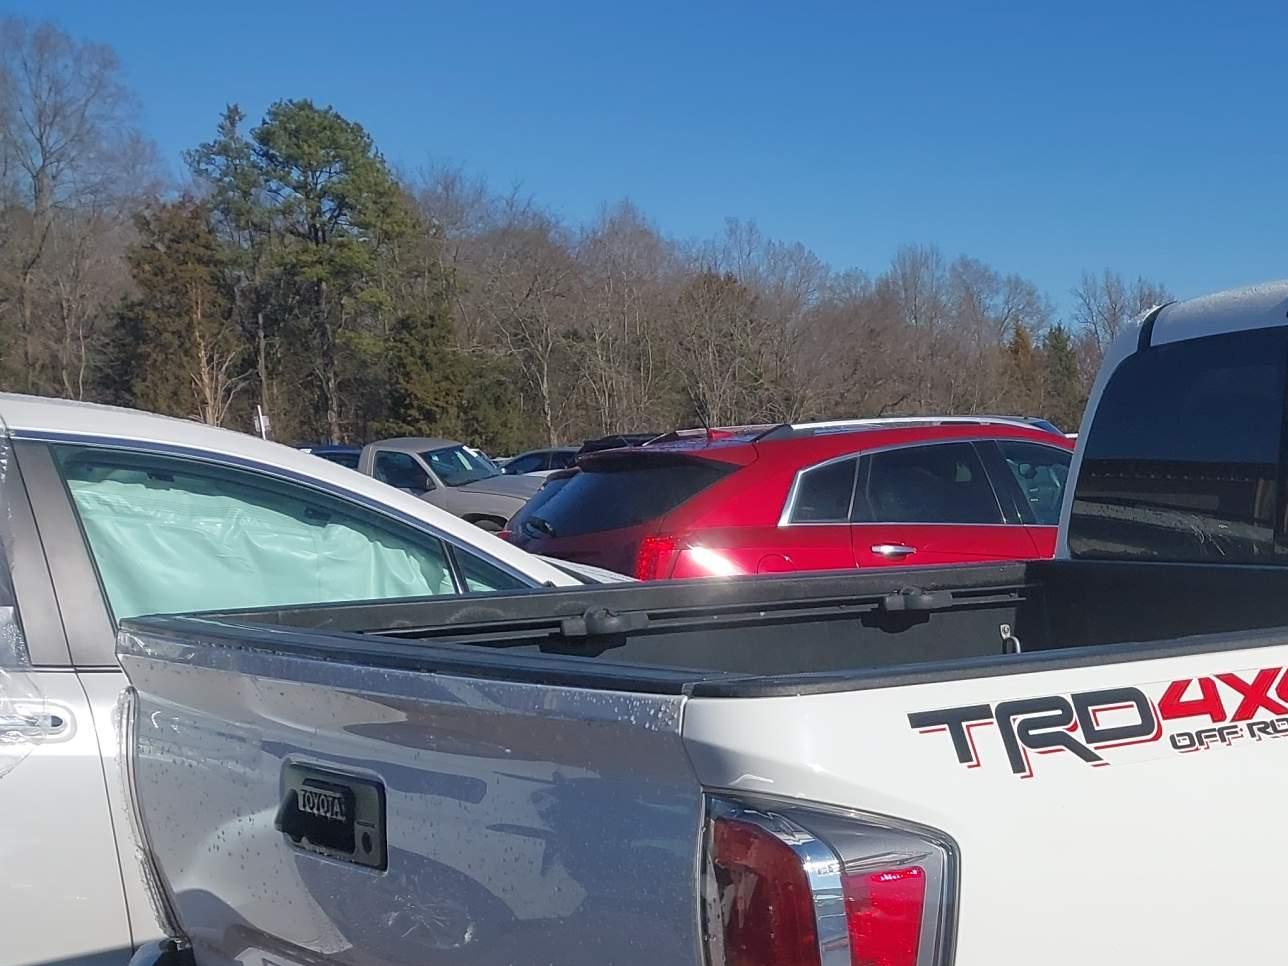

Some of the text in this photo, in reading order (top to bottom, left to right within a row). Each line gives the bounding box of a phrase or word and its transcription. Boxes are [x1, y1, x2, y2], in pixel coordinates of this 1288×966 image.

[907, 686, 1163, 779] TRD
[1168, 727, 1244, 753] OFF
[297, 789, 348, 822] TOYOTA
